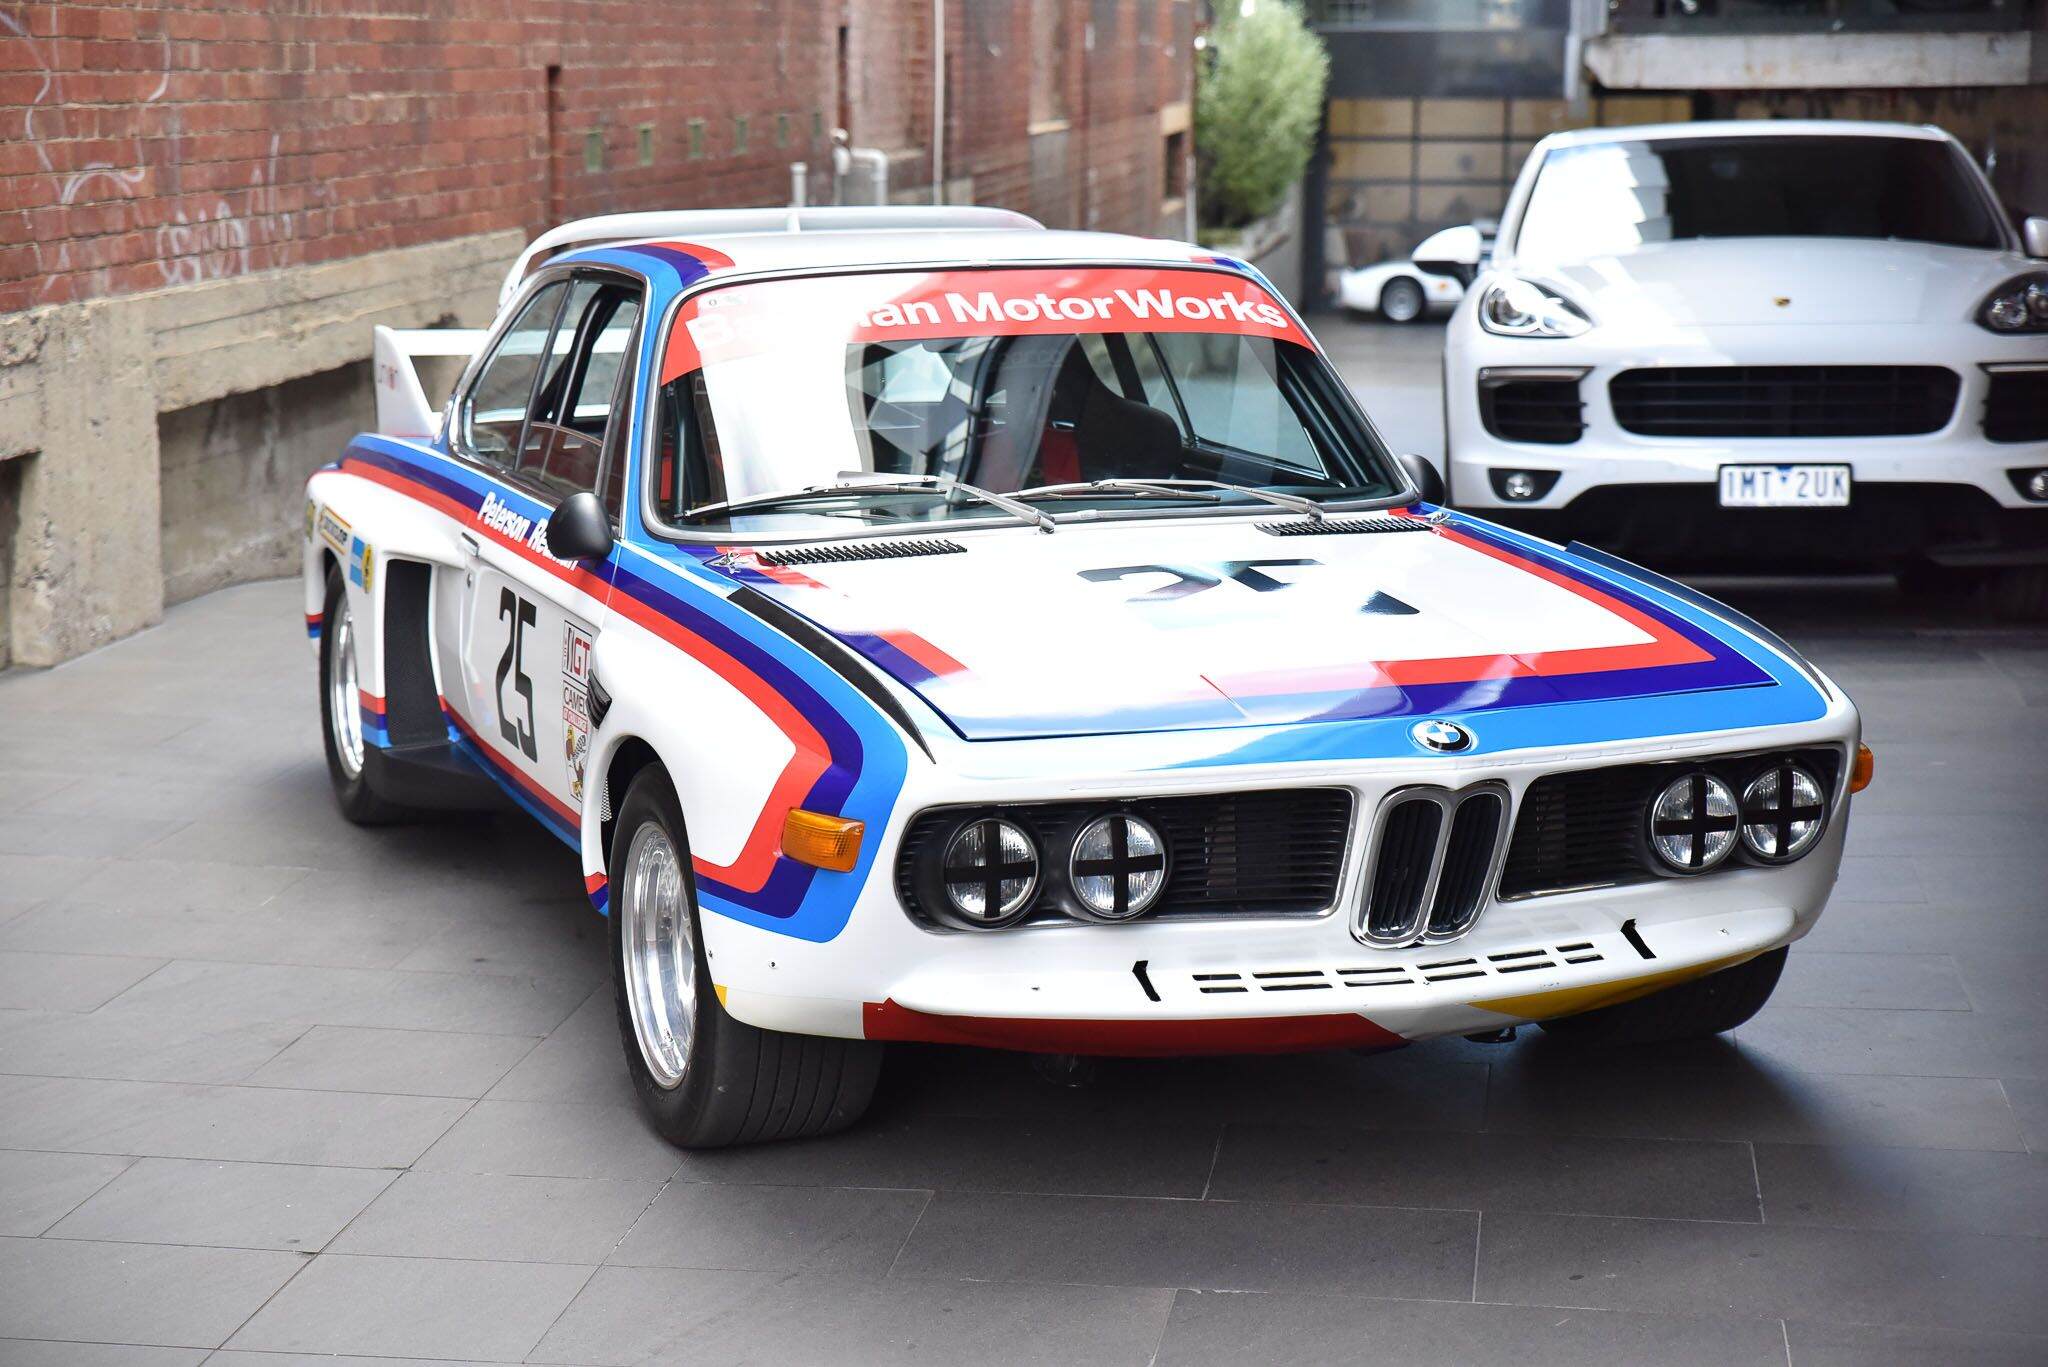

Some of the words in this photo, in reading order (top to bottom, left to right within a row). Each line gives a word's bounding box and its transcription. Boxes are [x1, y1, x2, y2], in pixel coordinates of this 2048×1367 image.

[945, 291, 1114, 323] Motor
[1113, 288, 1289, 329] Works
[1797, 471, 1847, 498] 2UK
[477, 491, 531, 542] Peterson
[495, 586, 538, 764] 25
[563, 686, 587, 717] CAMEL
